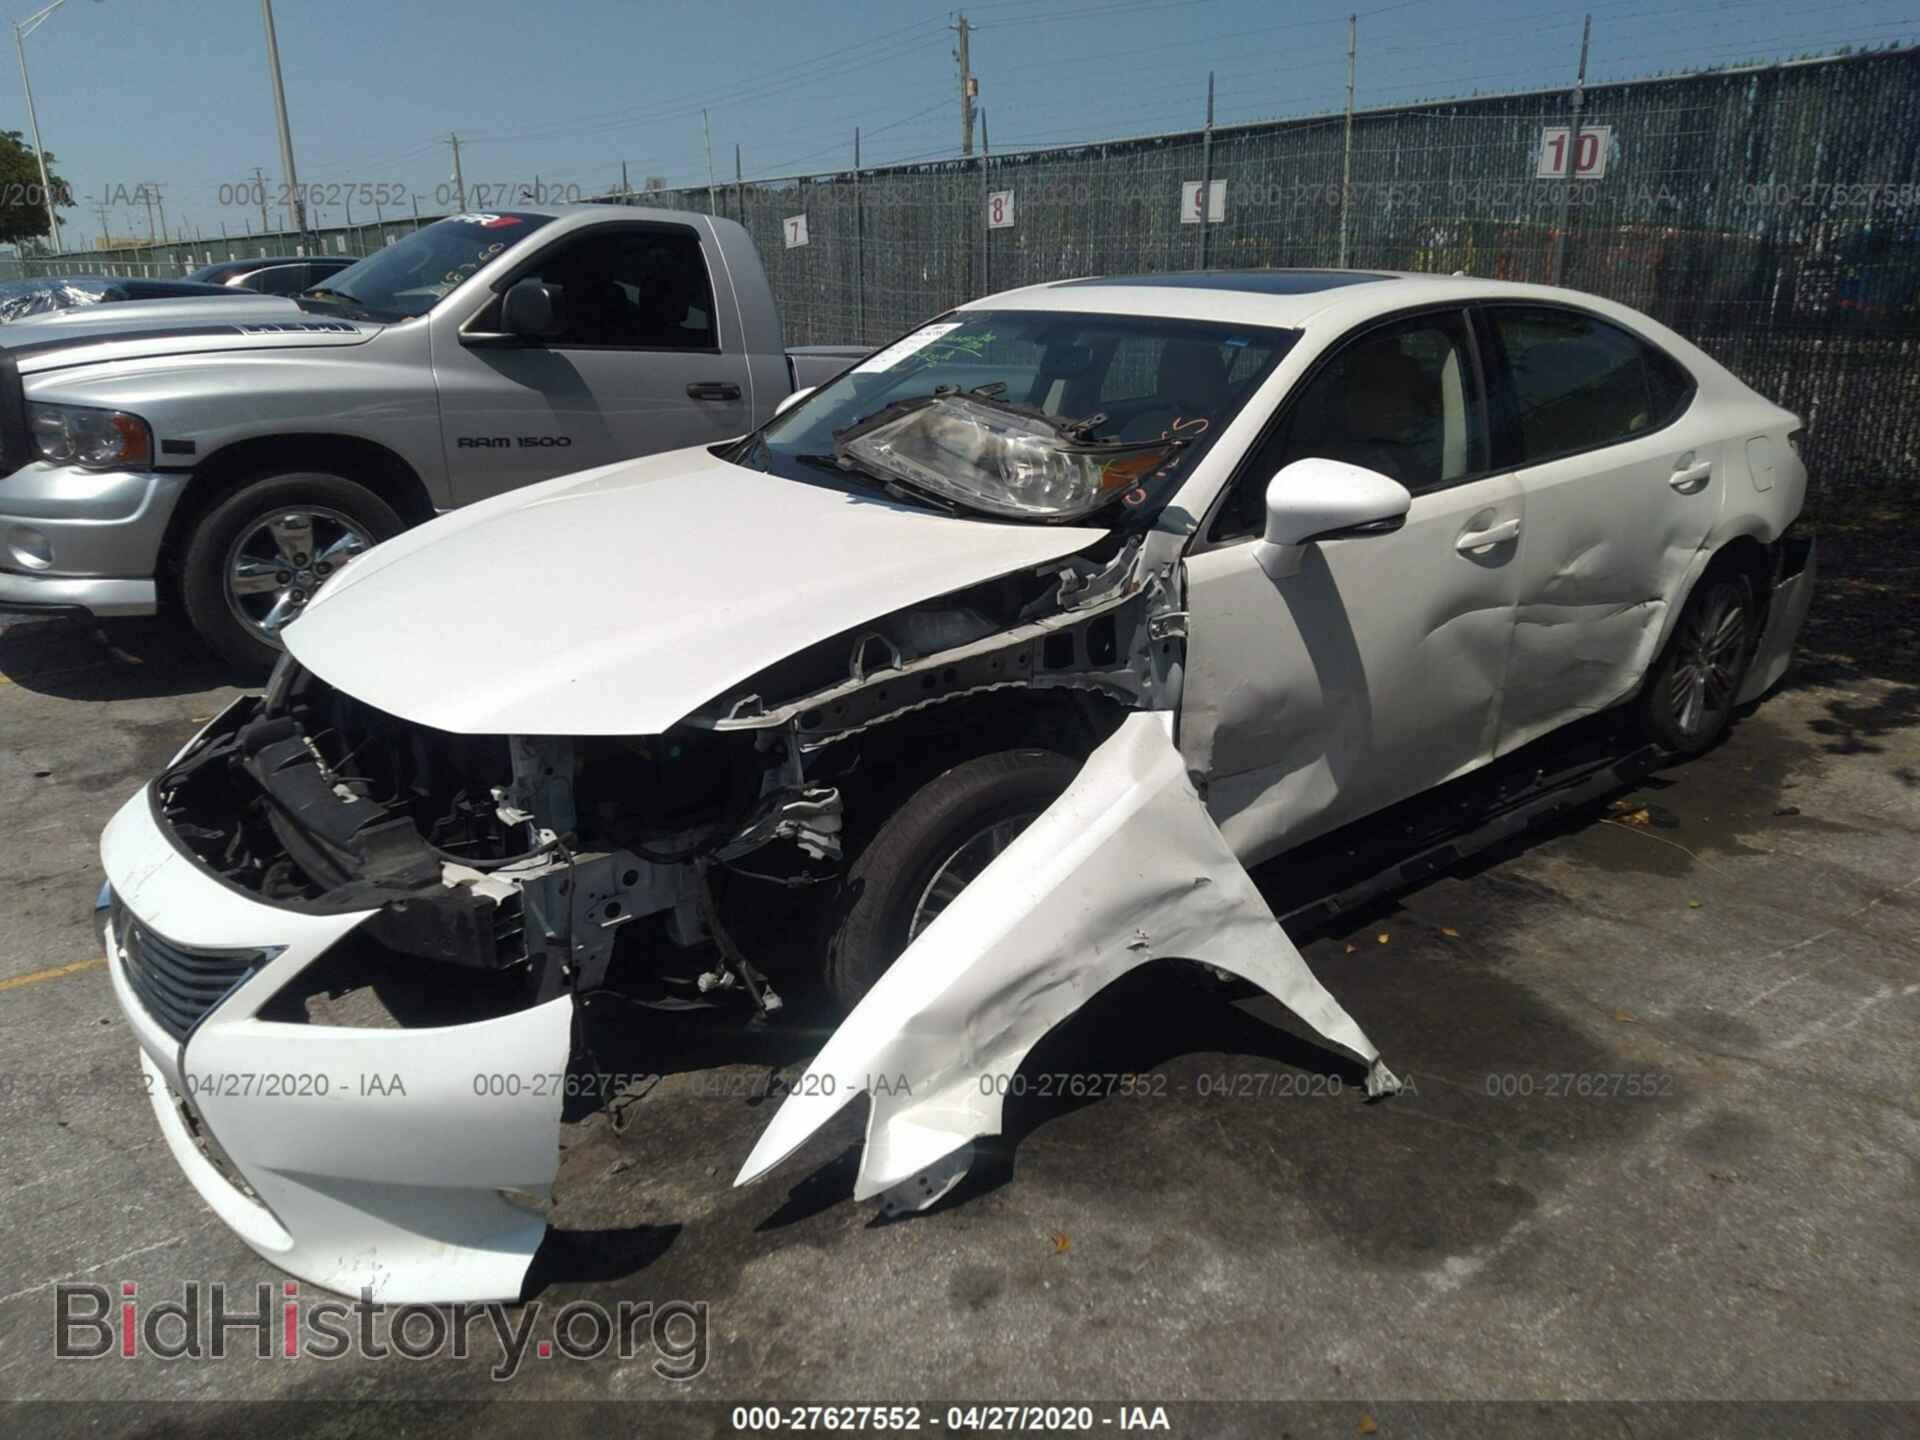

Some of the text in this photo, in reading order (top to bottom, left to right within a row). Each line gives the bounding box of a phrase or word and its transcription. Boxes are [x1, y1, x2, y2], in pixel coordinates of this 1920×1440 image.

[1547, 134, 1600, 172] 10
[992, 198, 1004, 223] 8
[790, 221, 799, 241] 7
[457, 436, 572, 448] RAM 1500
